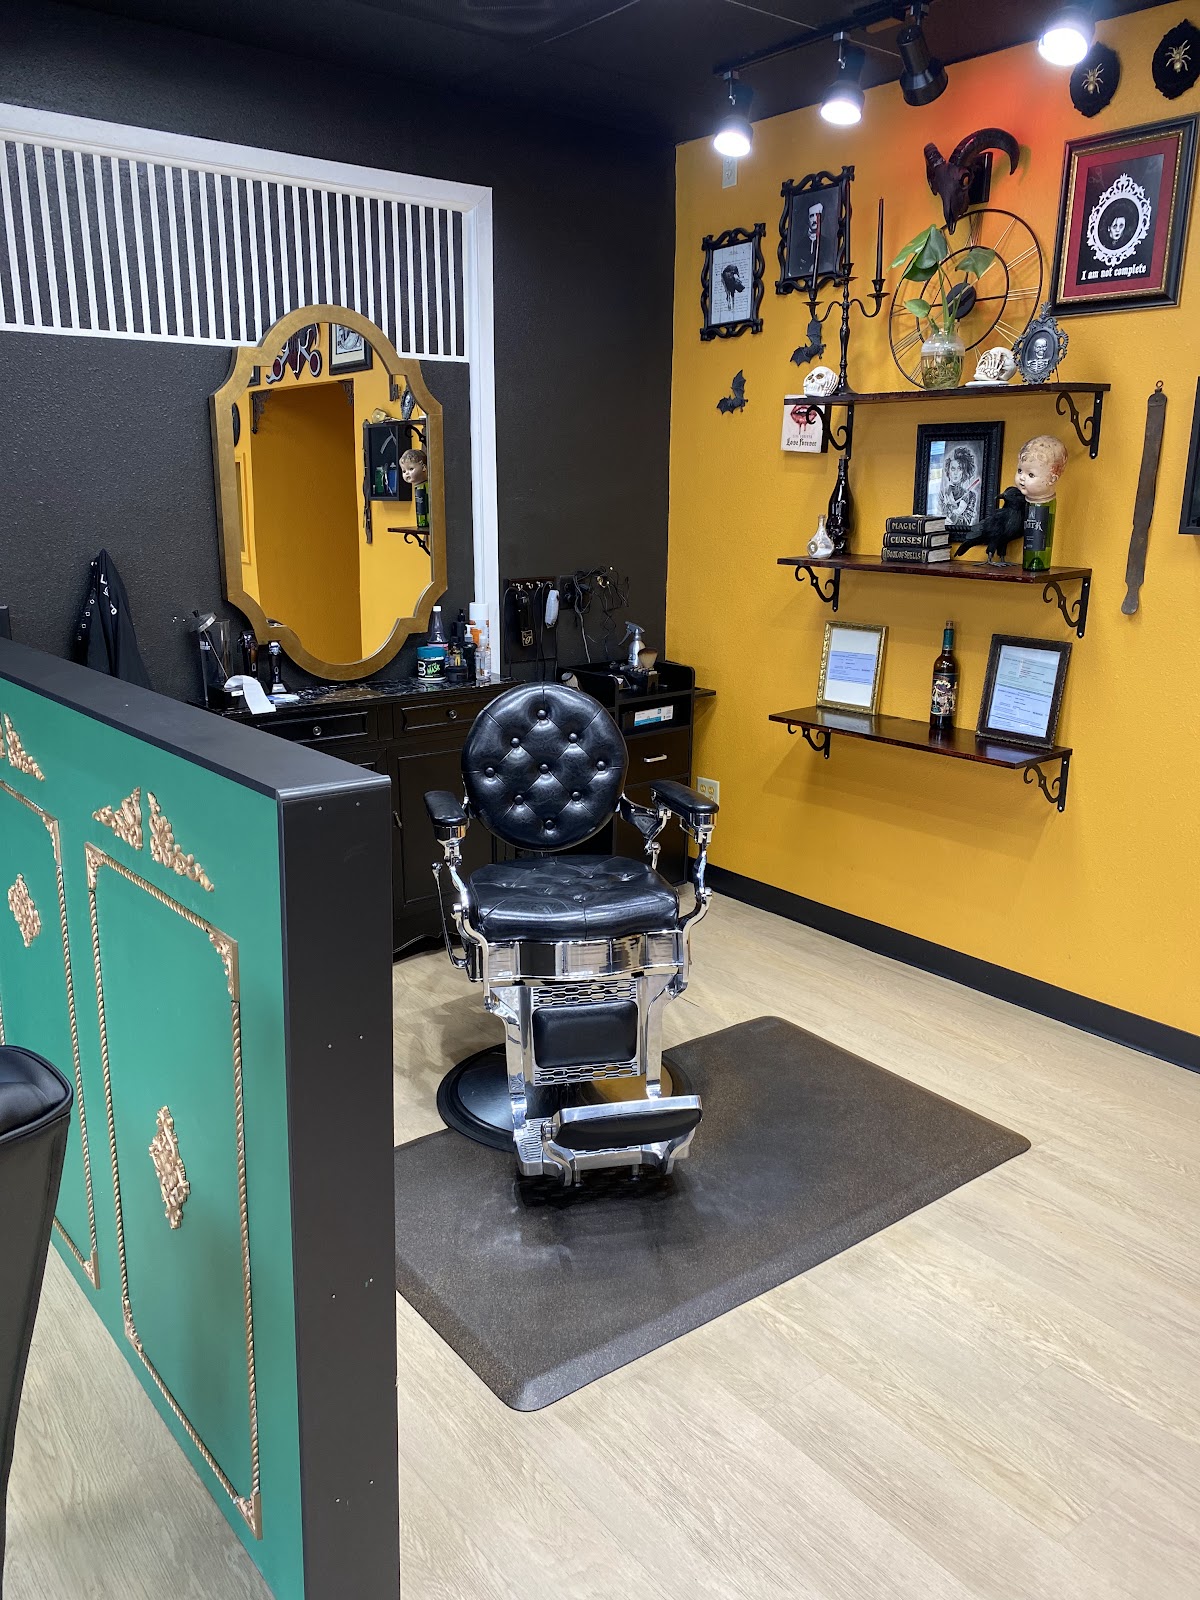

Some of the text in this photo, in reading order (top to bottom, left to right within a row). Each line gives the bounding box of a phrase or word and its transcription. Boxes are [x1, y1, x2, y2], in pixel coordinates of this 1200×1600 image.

[1081, 263, 1147, 280] I am not complete
[891, 522, 917, 530] MAGIC
[890, 536, 922, 545] CURSES
